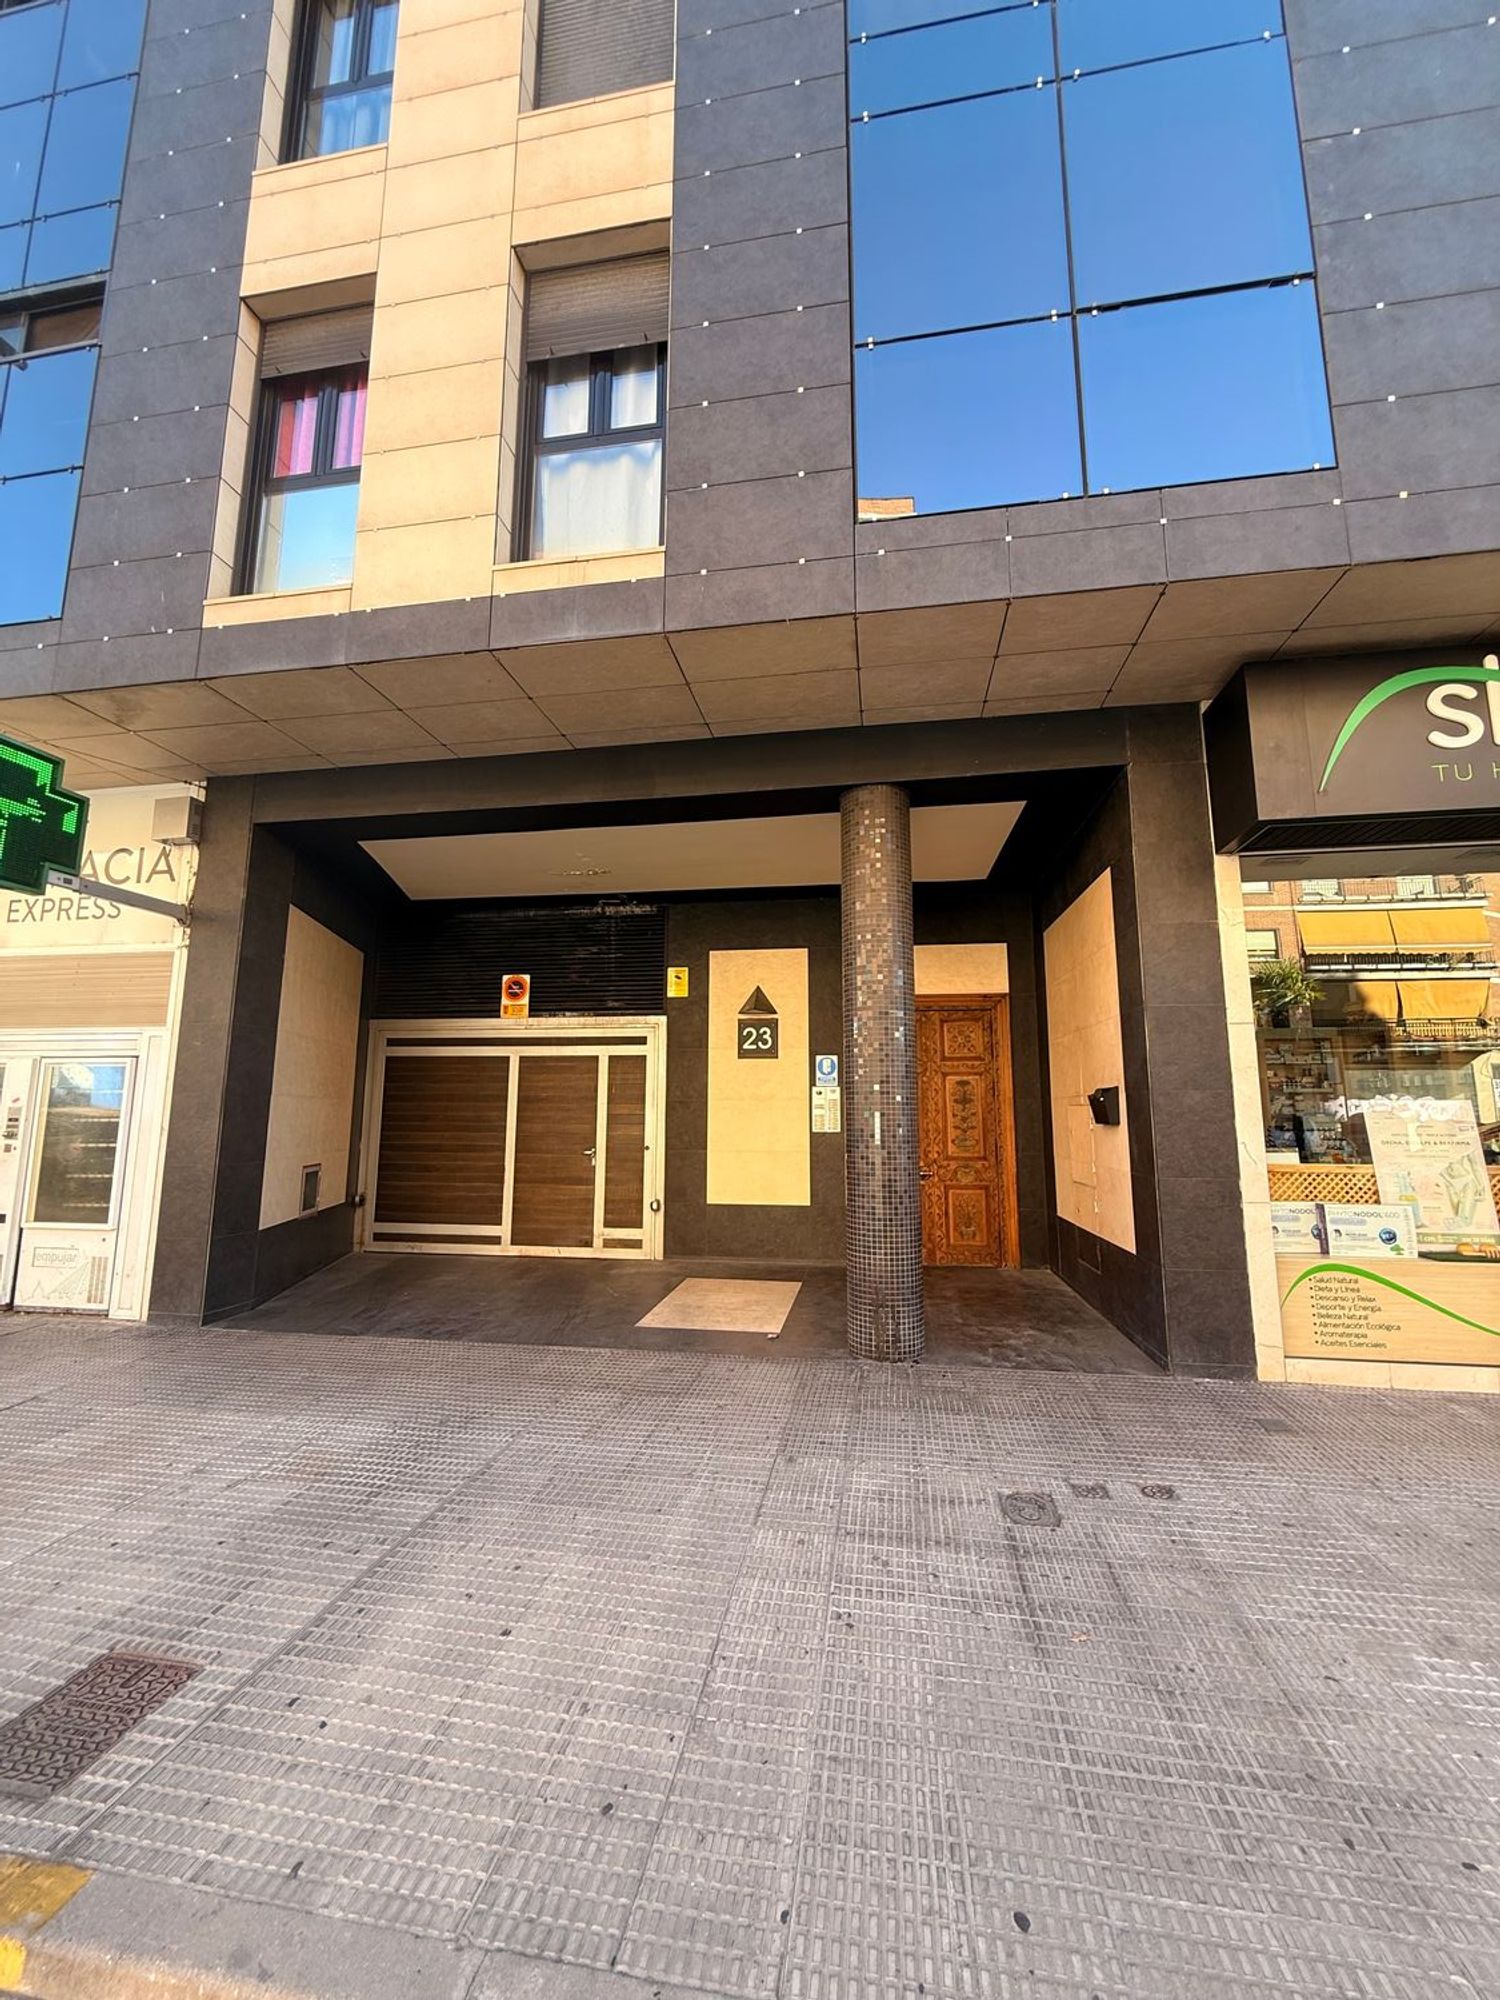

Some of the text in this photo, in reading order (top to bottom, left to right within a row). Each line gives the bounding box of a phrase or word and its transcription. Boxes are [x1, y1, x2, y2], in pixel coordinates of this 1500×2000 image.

[1431, 763, 1473, 782] TU
[80, 846, 176, 885] ACIA
[7, 896, 121, 923] EXPRESS
[742, 1027, 772, 1050] 23
[1315, 1294, 1349, 1302] Descanso
[1316, 1303, 1346, 1311] Deporte
[1354, 1304, 1382, 1313] Energía
[1319, 1321, 1401, 1331] Alimentación Ecológica
[1320, 1330, 1368, 1339] Aromaterapia
[1320, 1339, 1387, 1349] Aceites Esenciales
